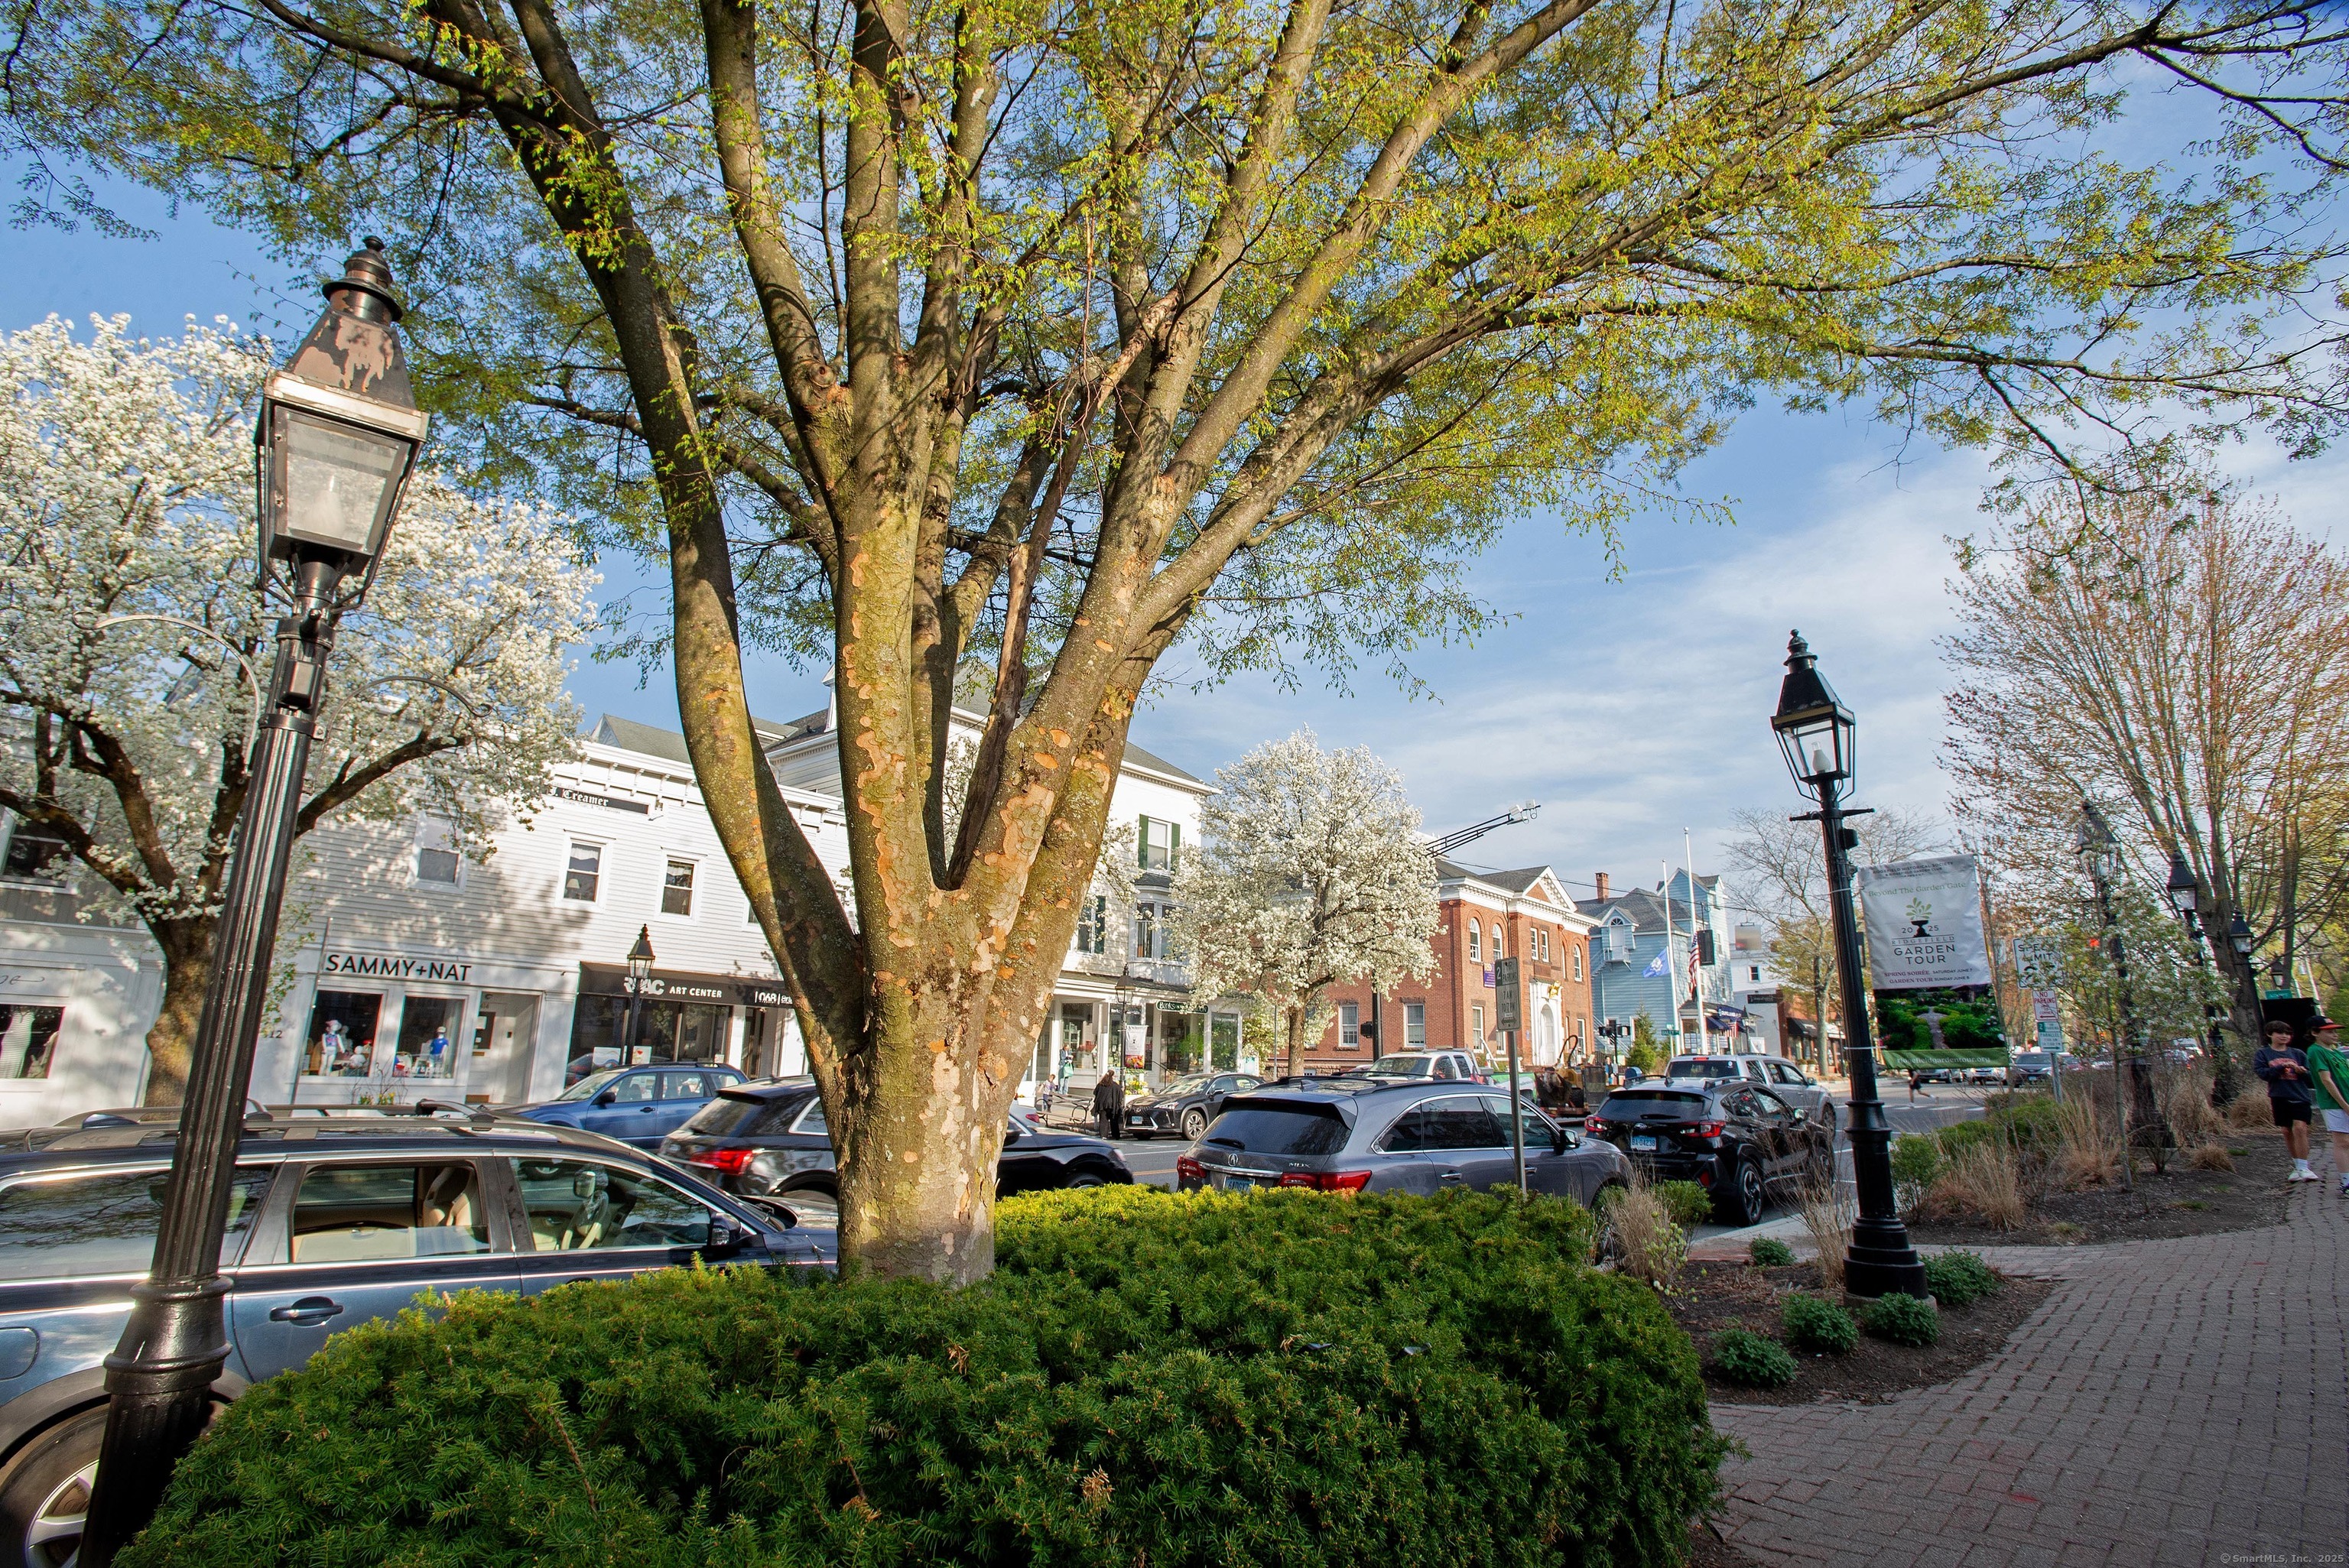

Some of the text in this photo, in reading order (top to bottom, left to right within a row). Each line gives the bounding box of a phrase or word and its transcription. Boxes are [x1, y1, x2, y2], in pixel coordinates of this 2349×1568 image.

[563, 789, 609, 807] Creamer
[1869, 888, 1897, 897] Beyond
[1892, 936, 1954, 945] RIDGEFIELD
[1894, 944, 1955, 956] GARDEN
[1906, 955, 1946, 964] TOUR
[326, 955, 472, 981] SAMMY+NAT
[1496, 966, 1501, 979] 2
[669, 985, 687, 995] ART
[689, 988, 723, 998] CENTER
